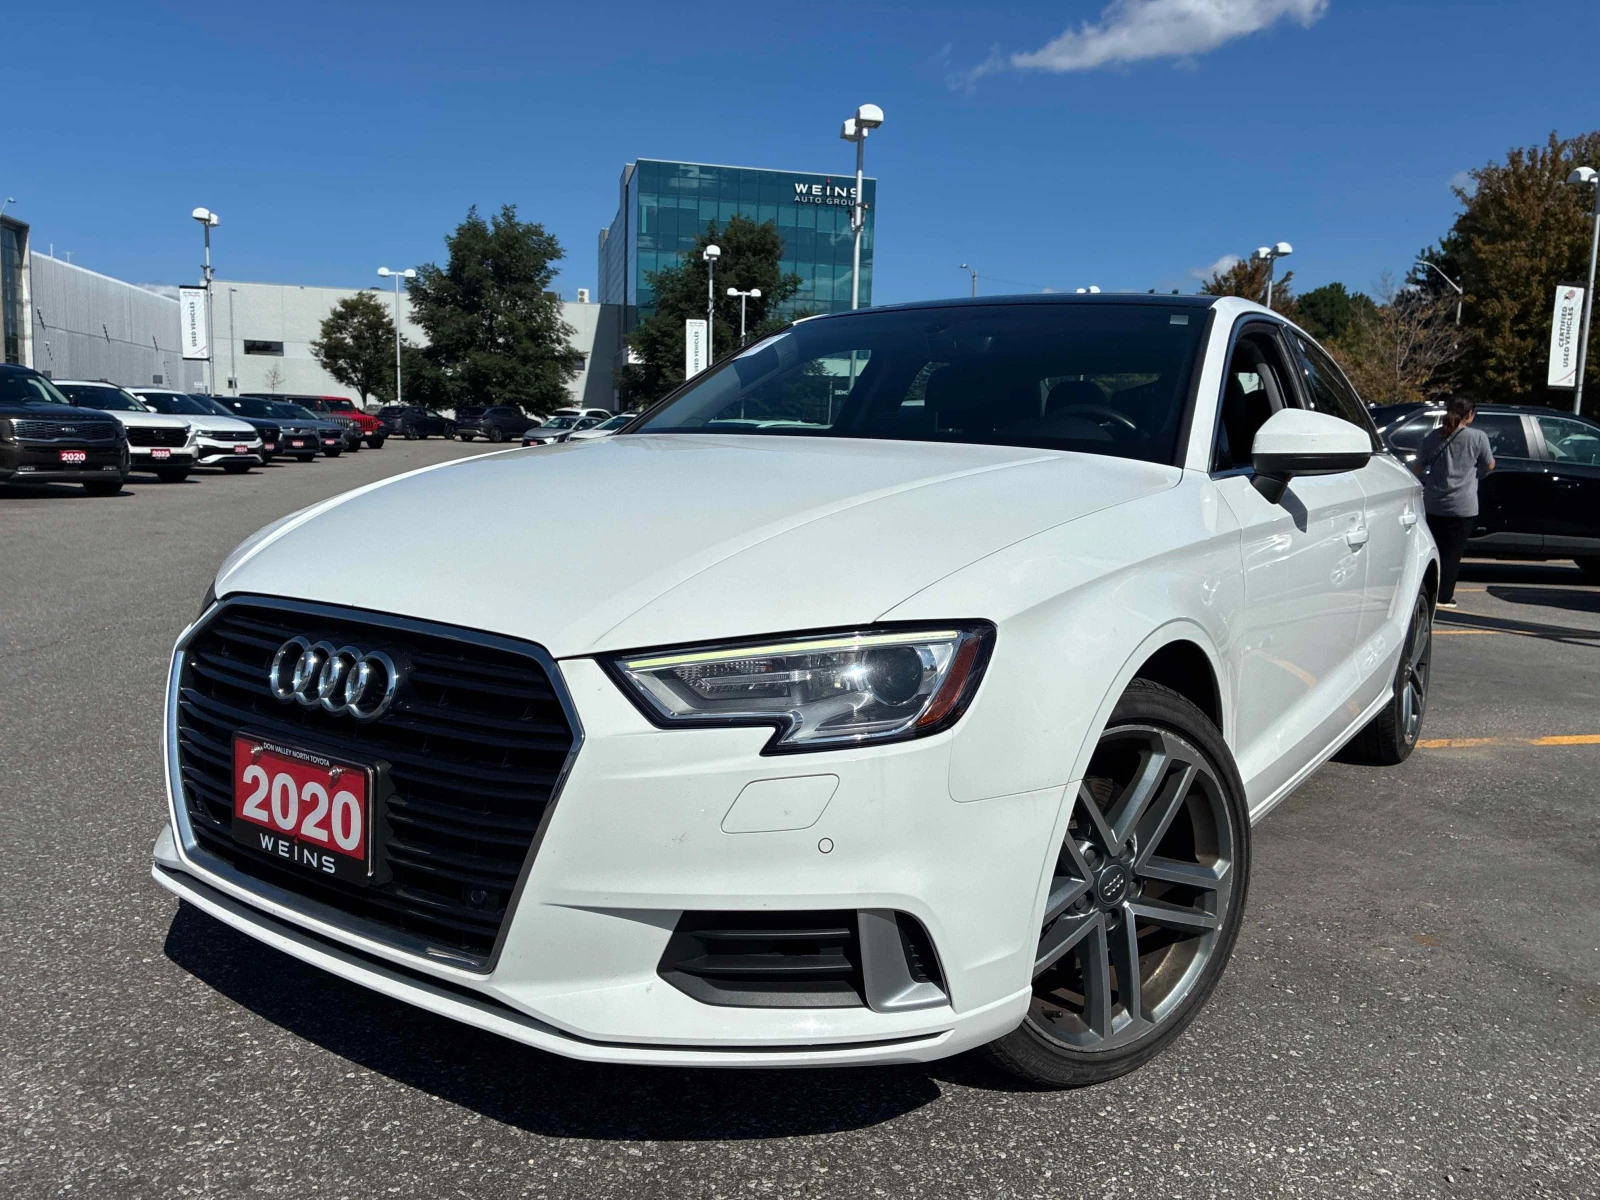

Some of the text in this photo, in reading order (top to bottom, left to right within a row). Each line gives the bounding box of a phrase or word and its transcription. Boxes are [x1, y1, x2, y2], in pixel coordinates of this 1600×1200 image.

[794, 181, 858, 198] WEINS
[794, 195, 855, 206] AUTO GROU
[1558, 306, 1568, 347] CERTIFIED
[1563, 307, 1574, 368] USED VEHICLES
[61, 453, 86, 461] 2020
[263, 742, 330, 767] DON VALLEY NORTH TOYOTA
[242, 765, 362, 851] 2020
[260, 833, 336, 874] WEINS
